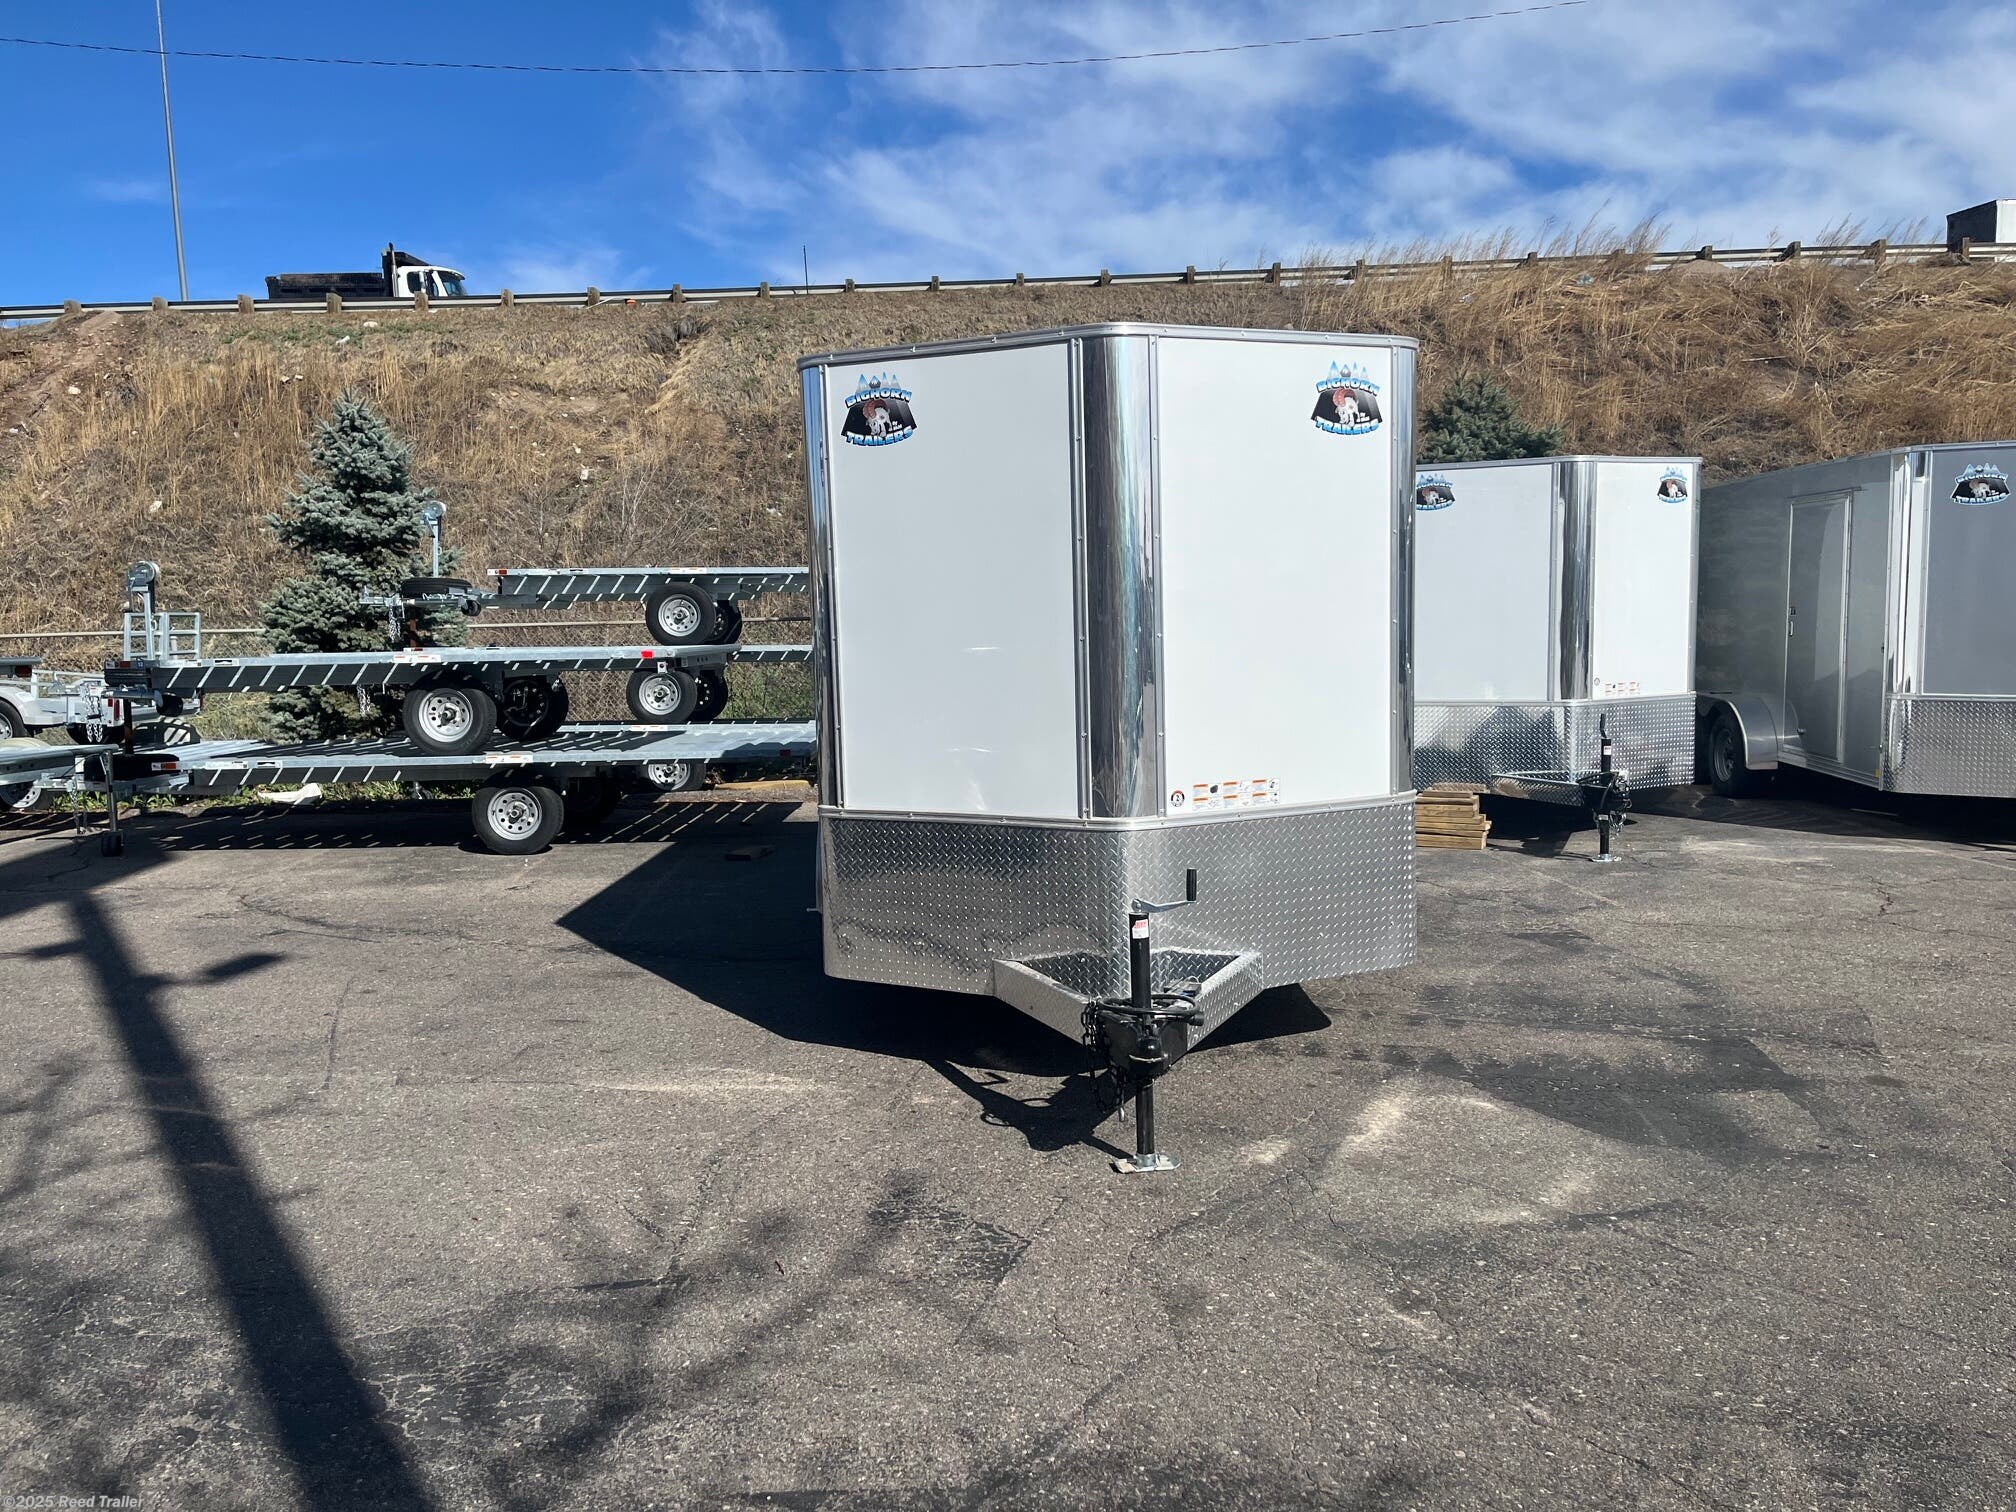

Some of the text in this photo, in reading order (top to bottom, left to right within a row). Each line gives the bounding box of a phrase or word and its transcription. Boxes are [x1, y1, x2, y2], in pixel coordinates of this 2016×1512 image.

[1316, 377, 1380, 396] BIGHORN
[844, 387, 912, 408] BIGHORN
[1315, 416, 1380, 435] TRAILERS
[846, 425, 913, 446] TRAILERS
[1956, 471, 2007, 483] BIGHORN
[1954, 493, 2007, 505] TRAILERS
